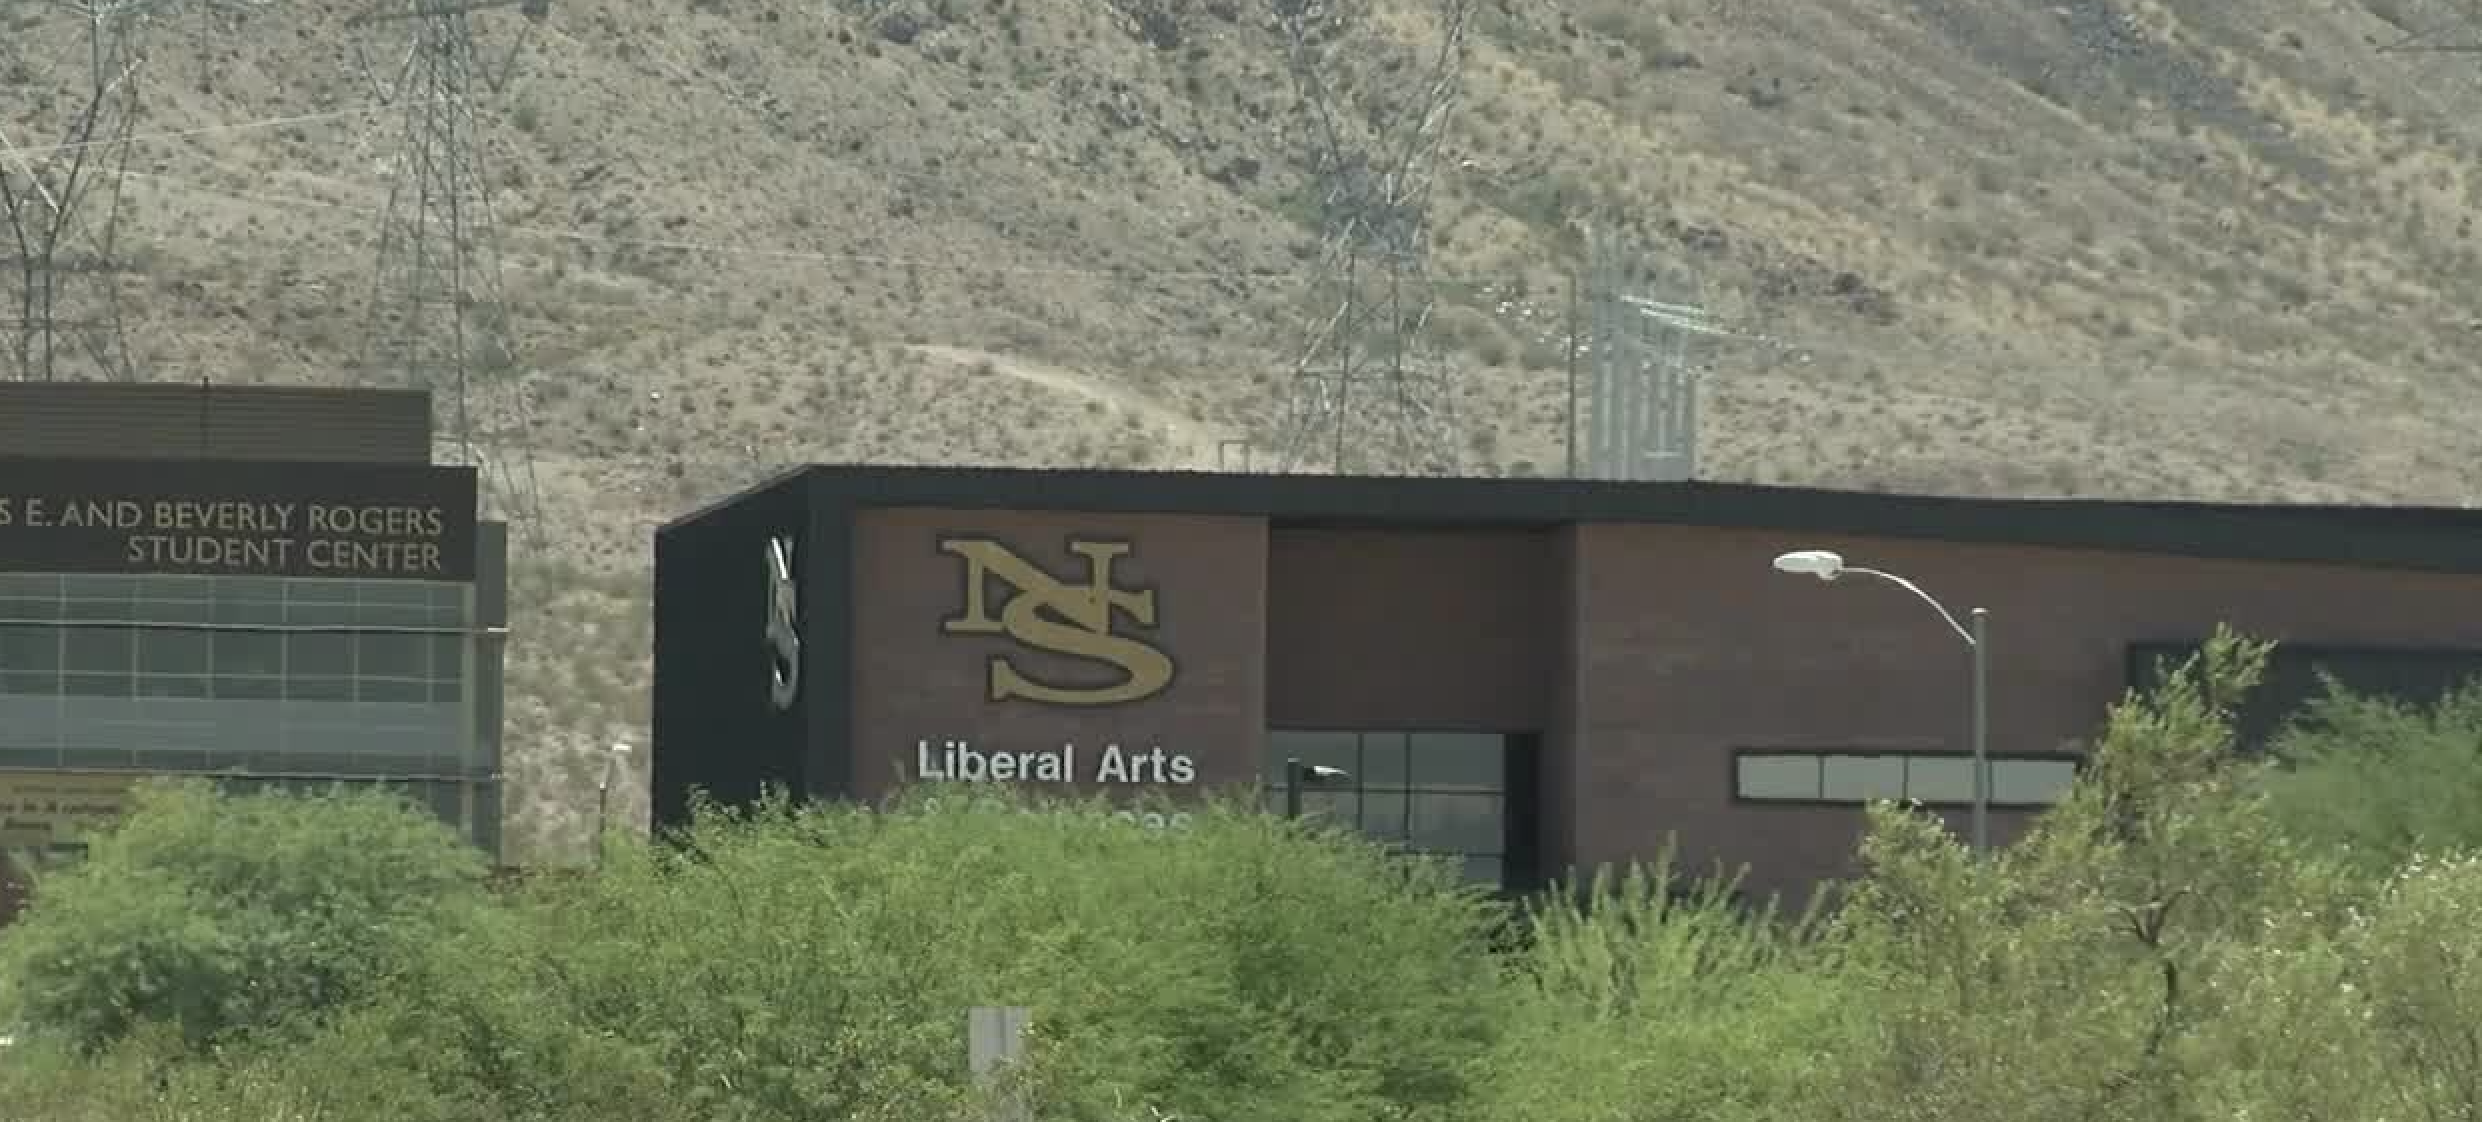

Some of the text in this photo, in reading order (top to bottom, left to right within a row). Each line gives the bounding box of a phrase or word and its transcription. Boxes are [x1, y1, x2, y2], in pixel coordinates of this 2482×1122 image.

[26, 499, 52, 527] E.
[61, 501, 142, 528] AND
[155, 503, 297, 532] BEVERLY
[309, 506, 444, 535] ROGERS
[128, 535, 441, 571] STUDENT CENTER
[939, 535, 1176, 706] NS
[917, 739, 1195, 783] Liberal Arts
